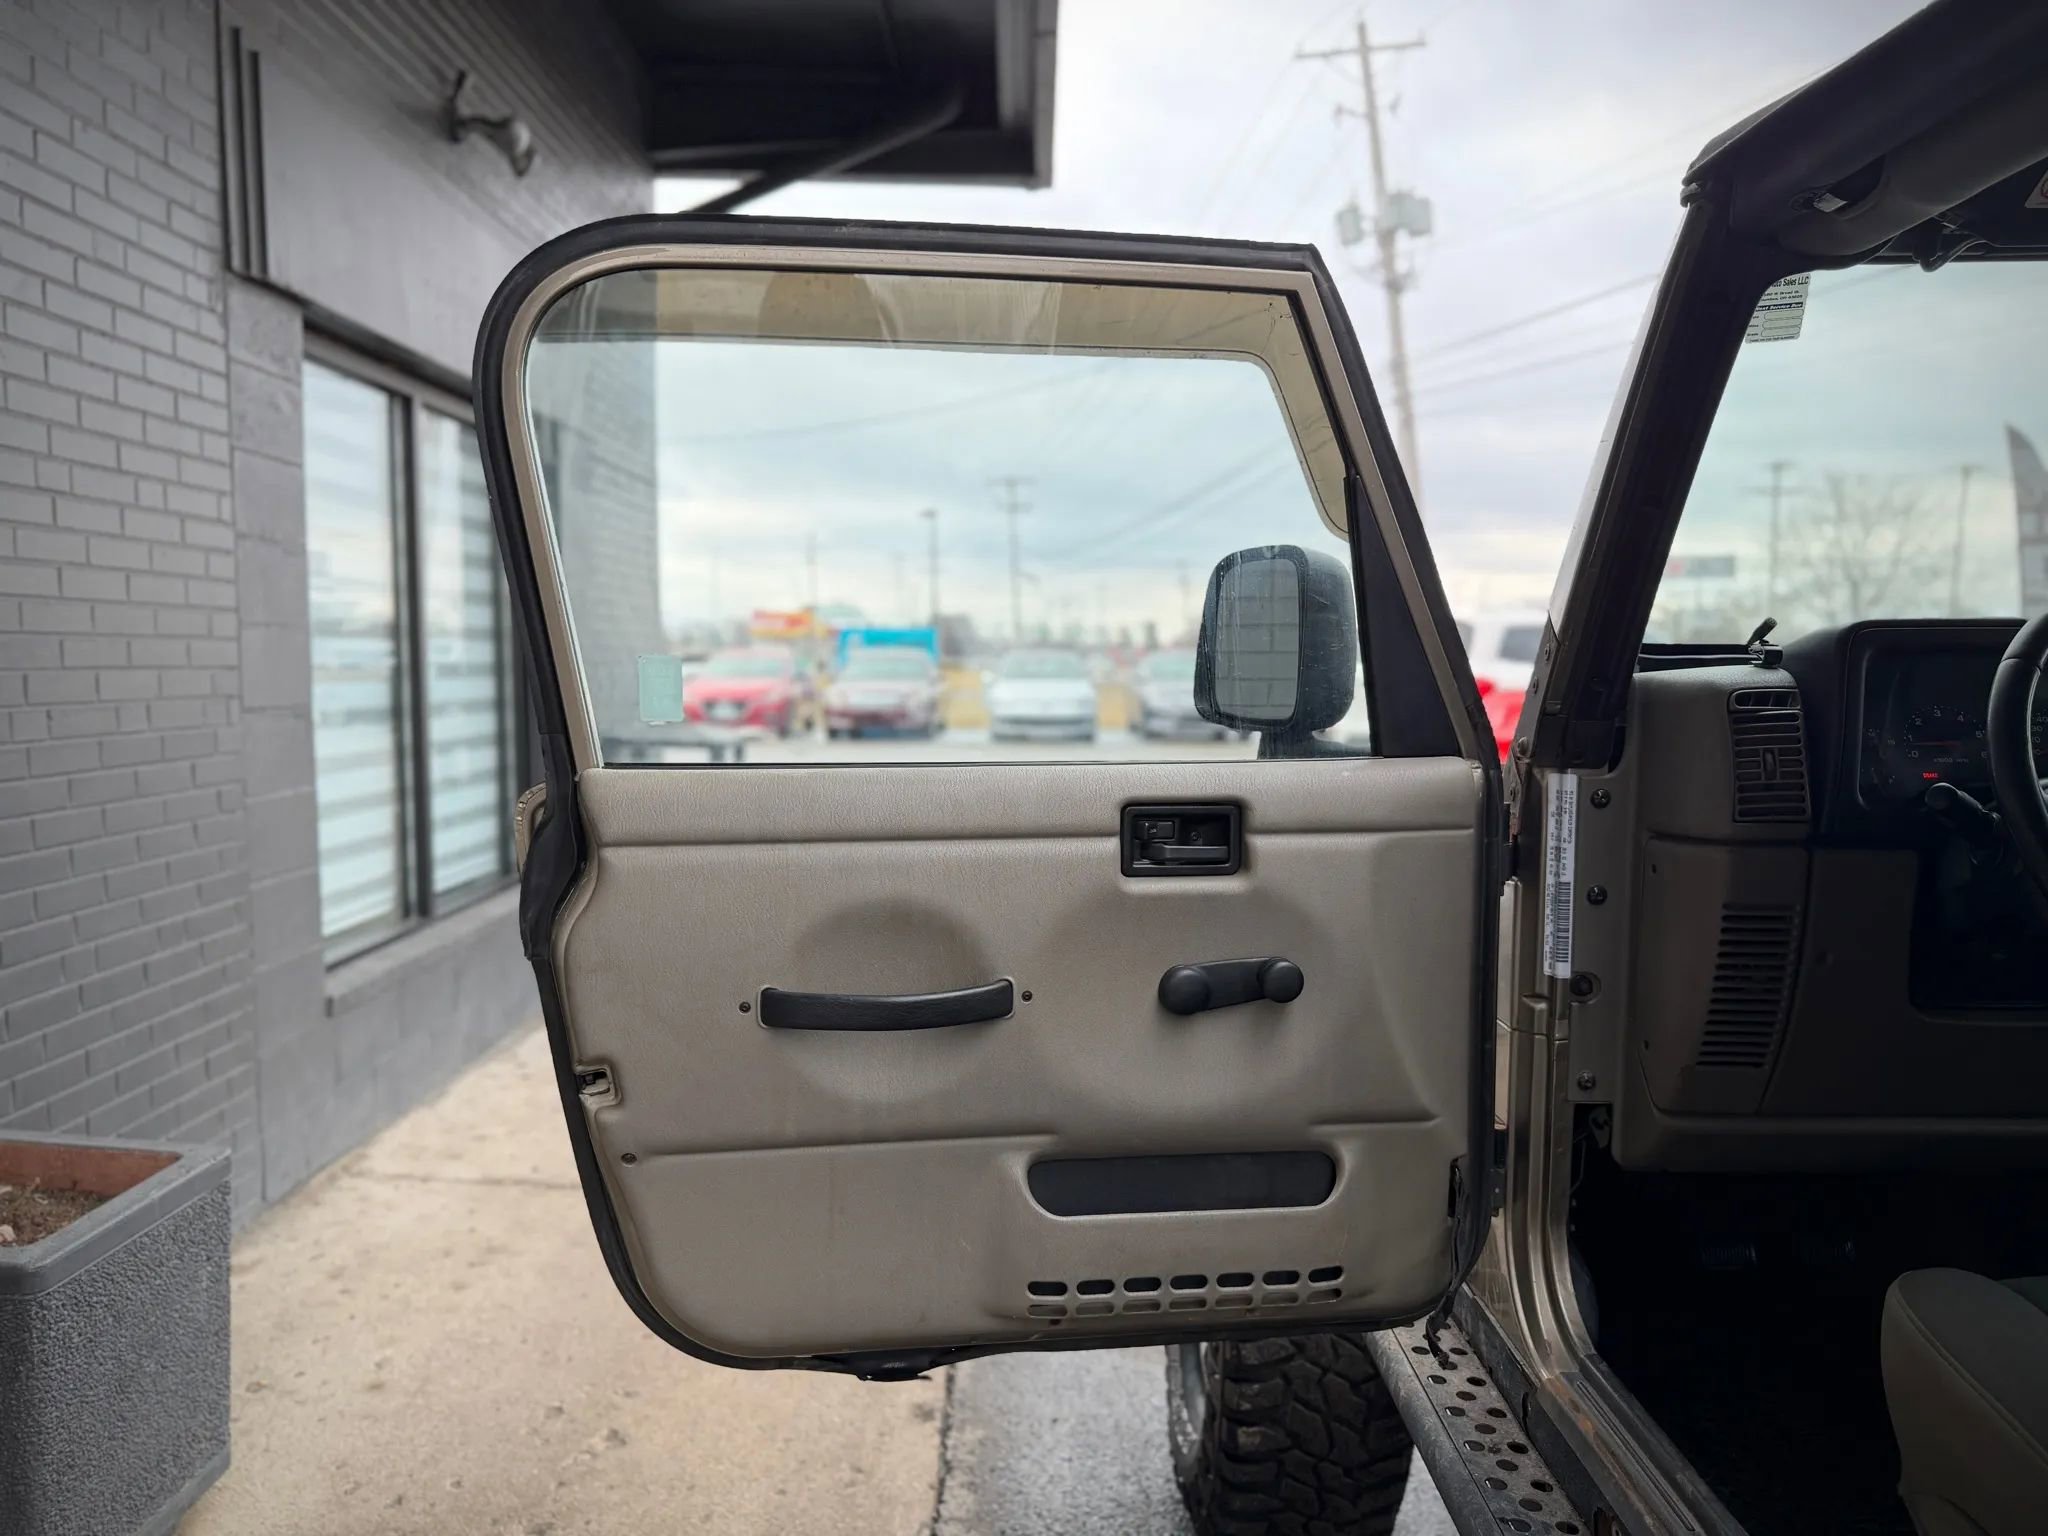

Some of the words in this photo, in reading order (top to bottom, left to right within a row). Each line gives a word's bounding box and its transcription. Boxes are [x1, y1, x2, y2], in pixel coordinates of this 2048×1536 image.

[1783, 277, 1797, 287] Sales
[1798, 276, 1809, 285] LLC
[1934, 709, 1942, 717] 3
[1915, 718, 1922, 726] 2
[1957, 714, 1964, 722] 4
[1975, 730, 1983, 738] 5
[1911, 750, 1919, 758] 0
